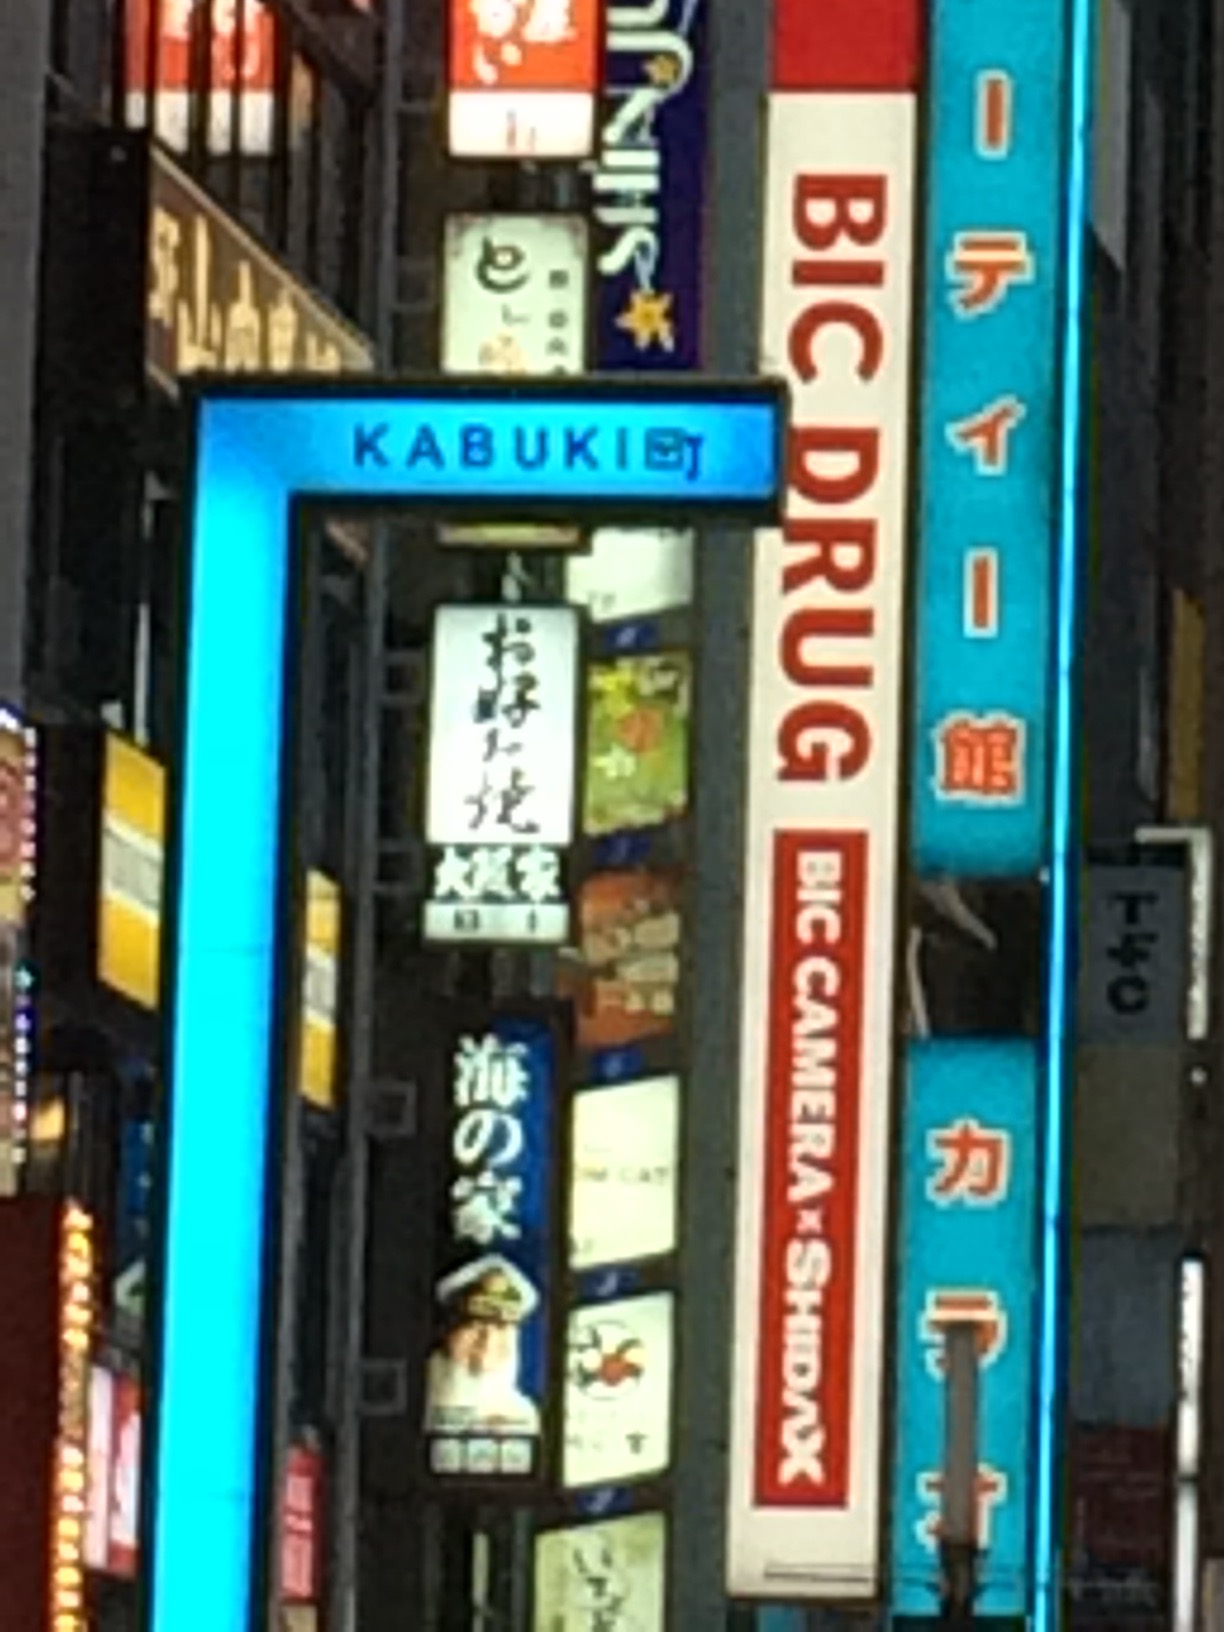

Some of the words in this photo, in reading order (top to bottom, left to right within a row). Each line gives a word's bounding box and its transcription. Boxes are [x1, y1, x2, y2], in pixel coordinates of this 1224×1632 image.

[788, 174, 887, 384] BIC
[775, 427, 881, 784] DRUG
[796, 850, 844, 945] BIC
[452, 1032, 531, 1243] 海の家
[787, 956, 839, 1202] CAMERA
[779, 1238, 831, 1485] SHIDAX
